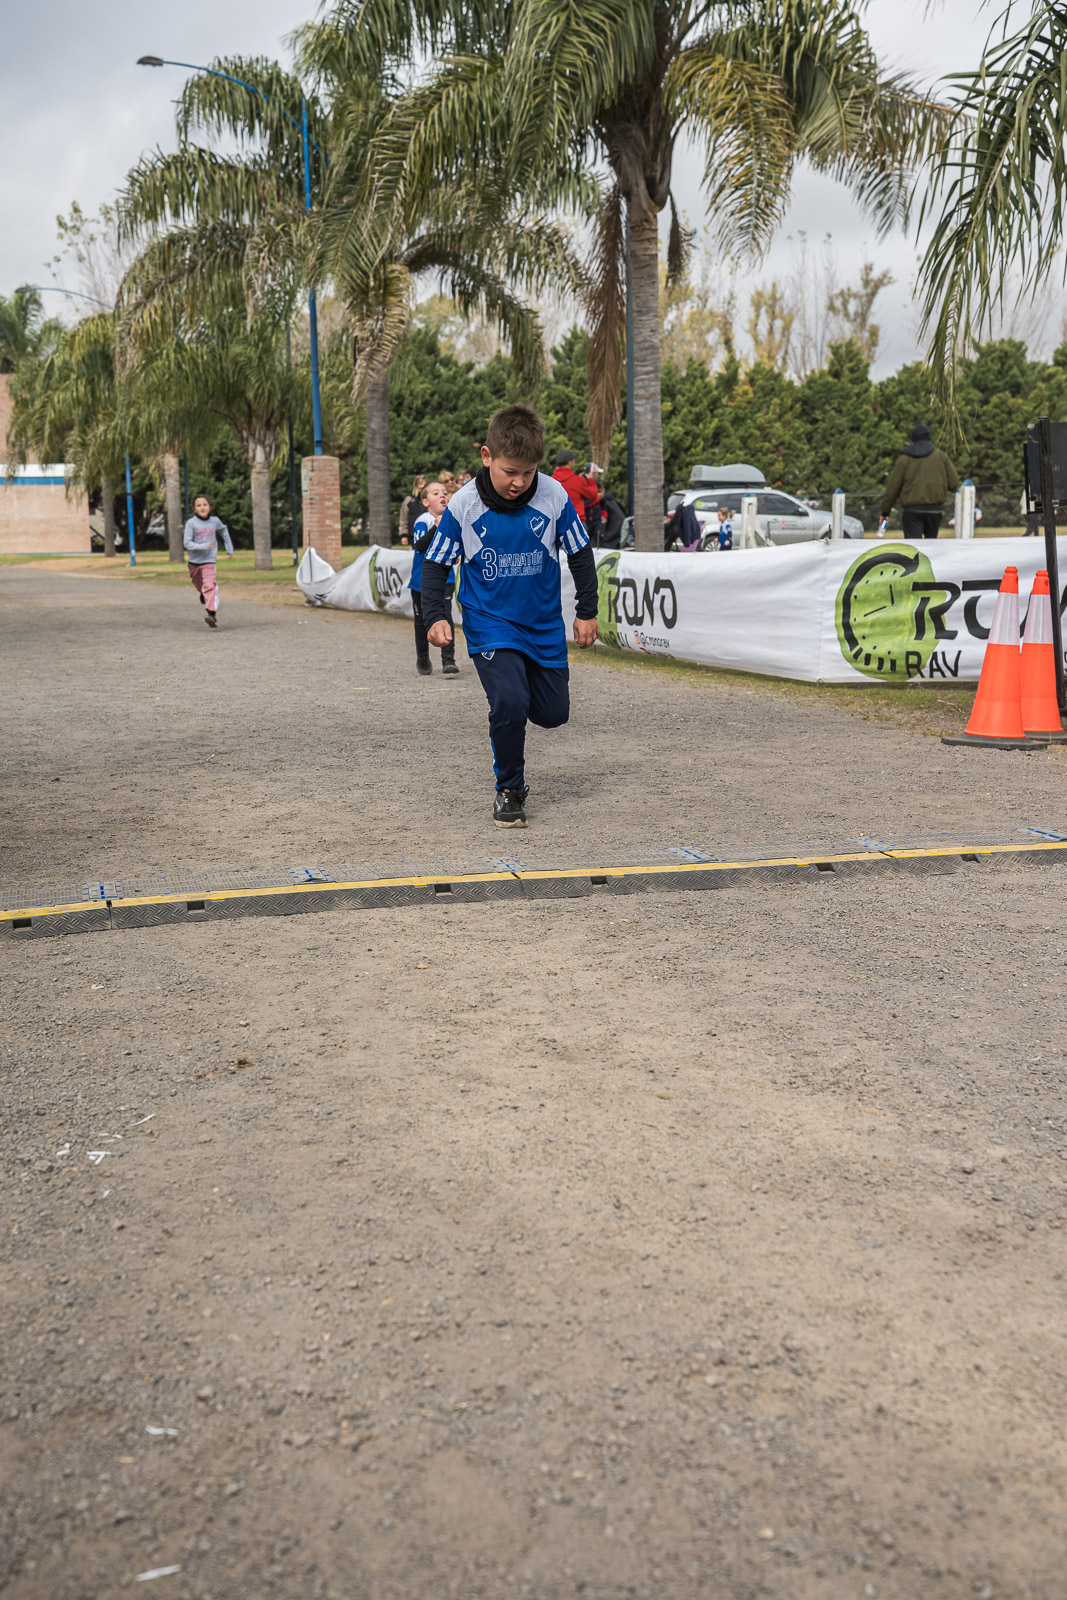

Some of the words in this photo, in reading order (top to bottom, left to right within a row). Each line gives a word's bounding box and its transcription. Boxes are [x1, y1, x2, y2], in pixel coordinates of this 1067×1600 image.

[481, 547, 498, 581] 3
[498, 549, 544, 567] MARATÓN
[905, 650, 962, 678] RAV
